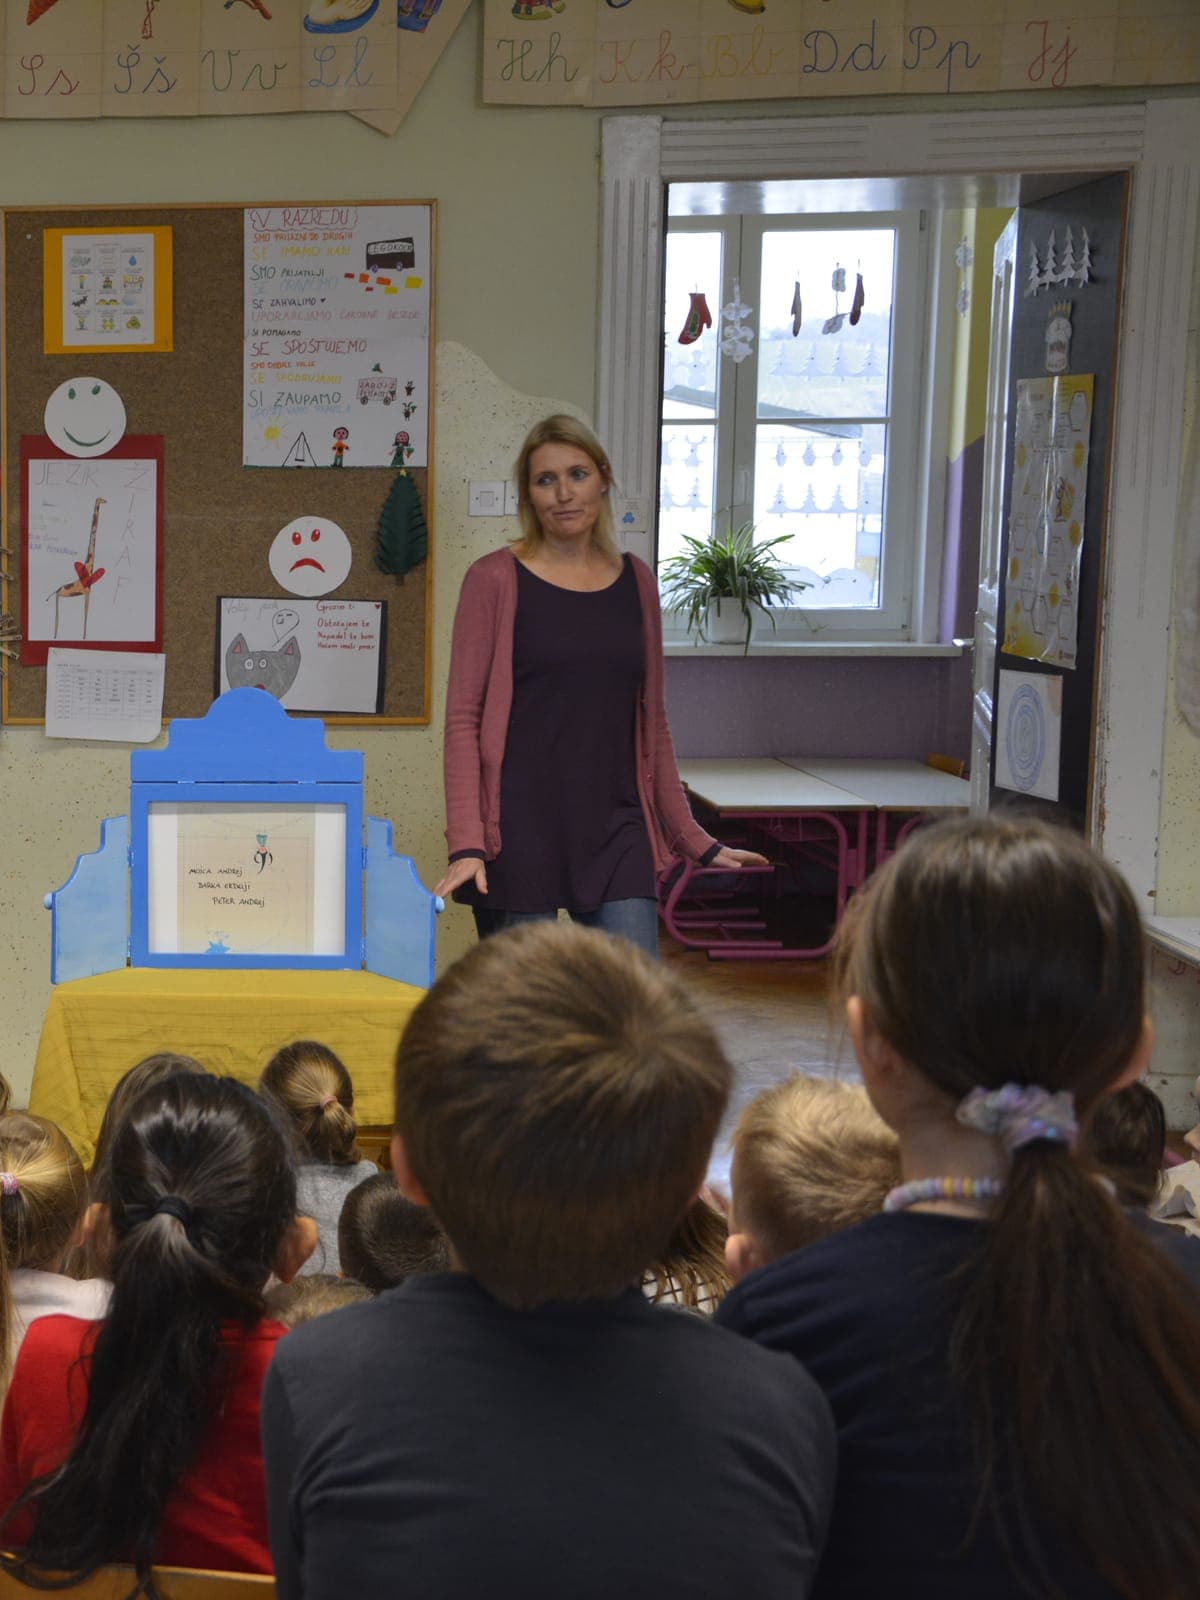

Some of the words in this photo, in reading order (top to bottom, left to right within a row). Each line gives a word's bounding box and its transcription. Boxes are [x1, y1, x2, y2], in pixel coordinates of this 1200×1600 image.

[282, 208, 350, 227] RAZREDU
[250, 264, 276, 281] SMO
[272, 390, 343, 408] ZAUPAMO
